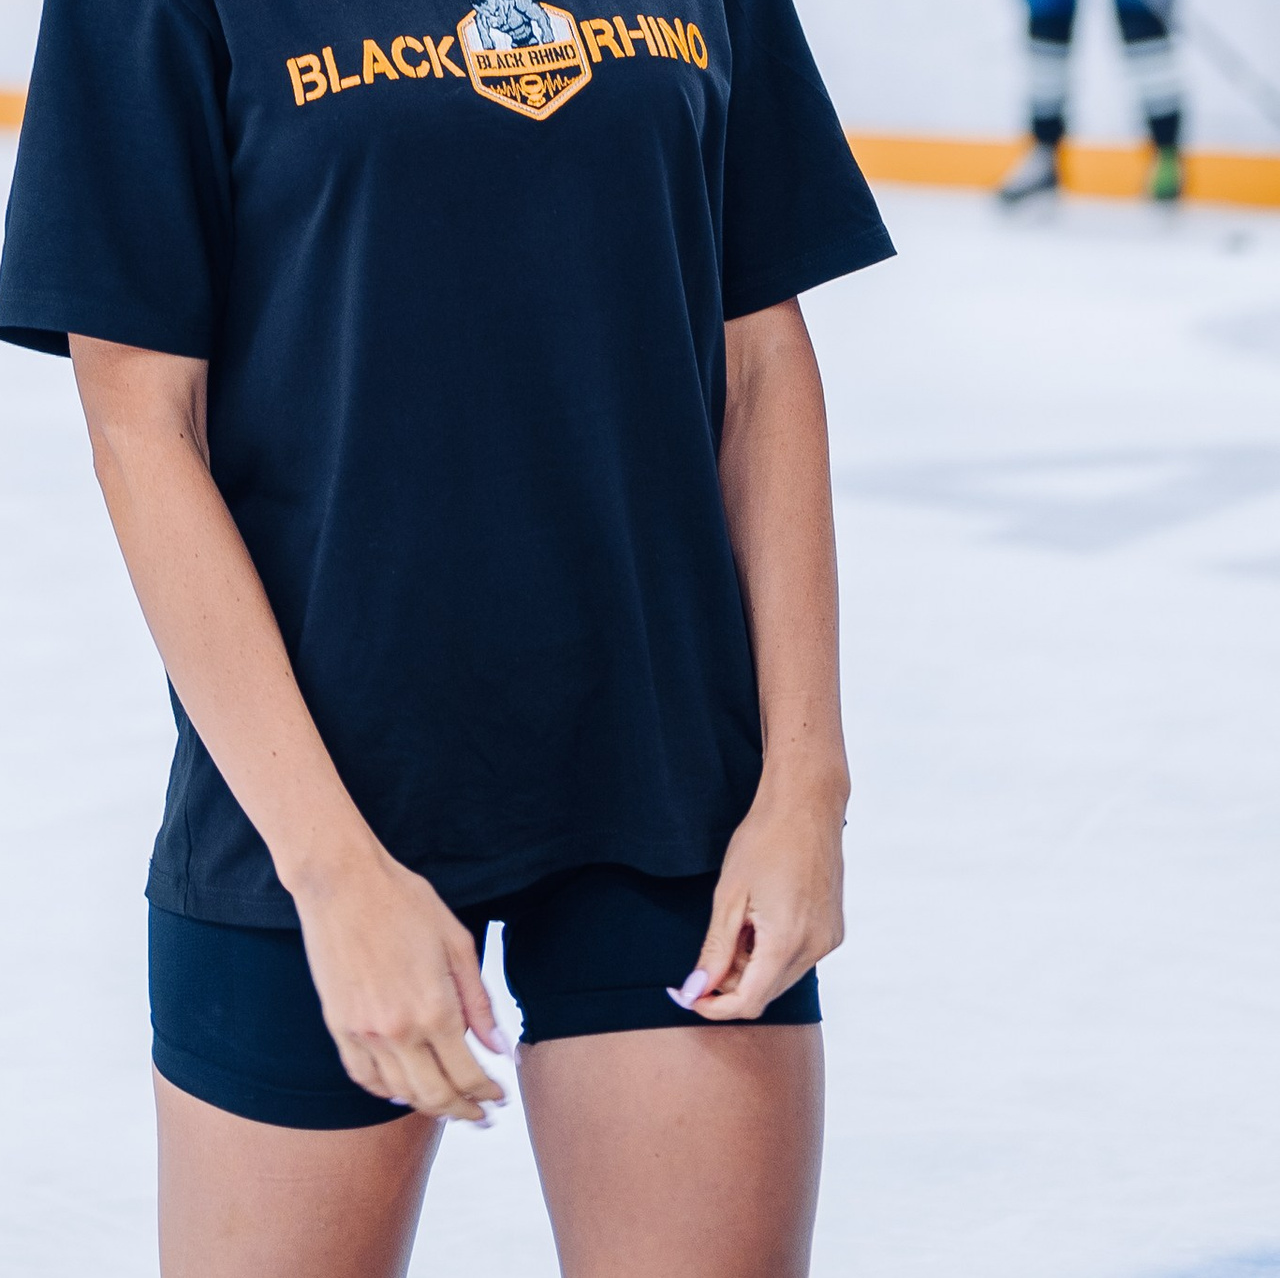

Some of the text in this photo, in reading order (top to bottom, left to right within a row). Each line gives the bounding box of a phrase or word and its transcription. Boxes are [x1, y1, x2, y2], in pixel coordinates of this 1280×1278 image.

[286, 14, 708, 106] BLACK RHINO
[475, 44, 577, 71] BLACK RHINO
